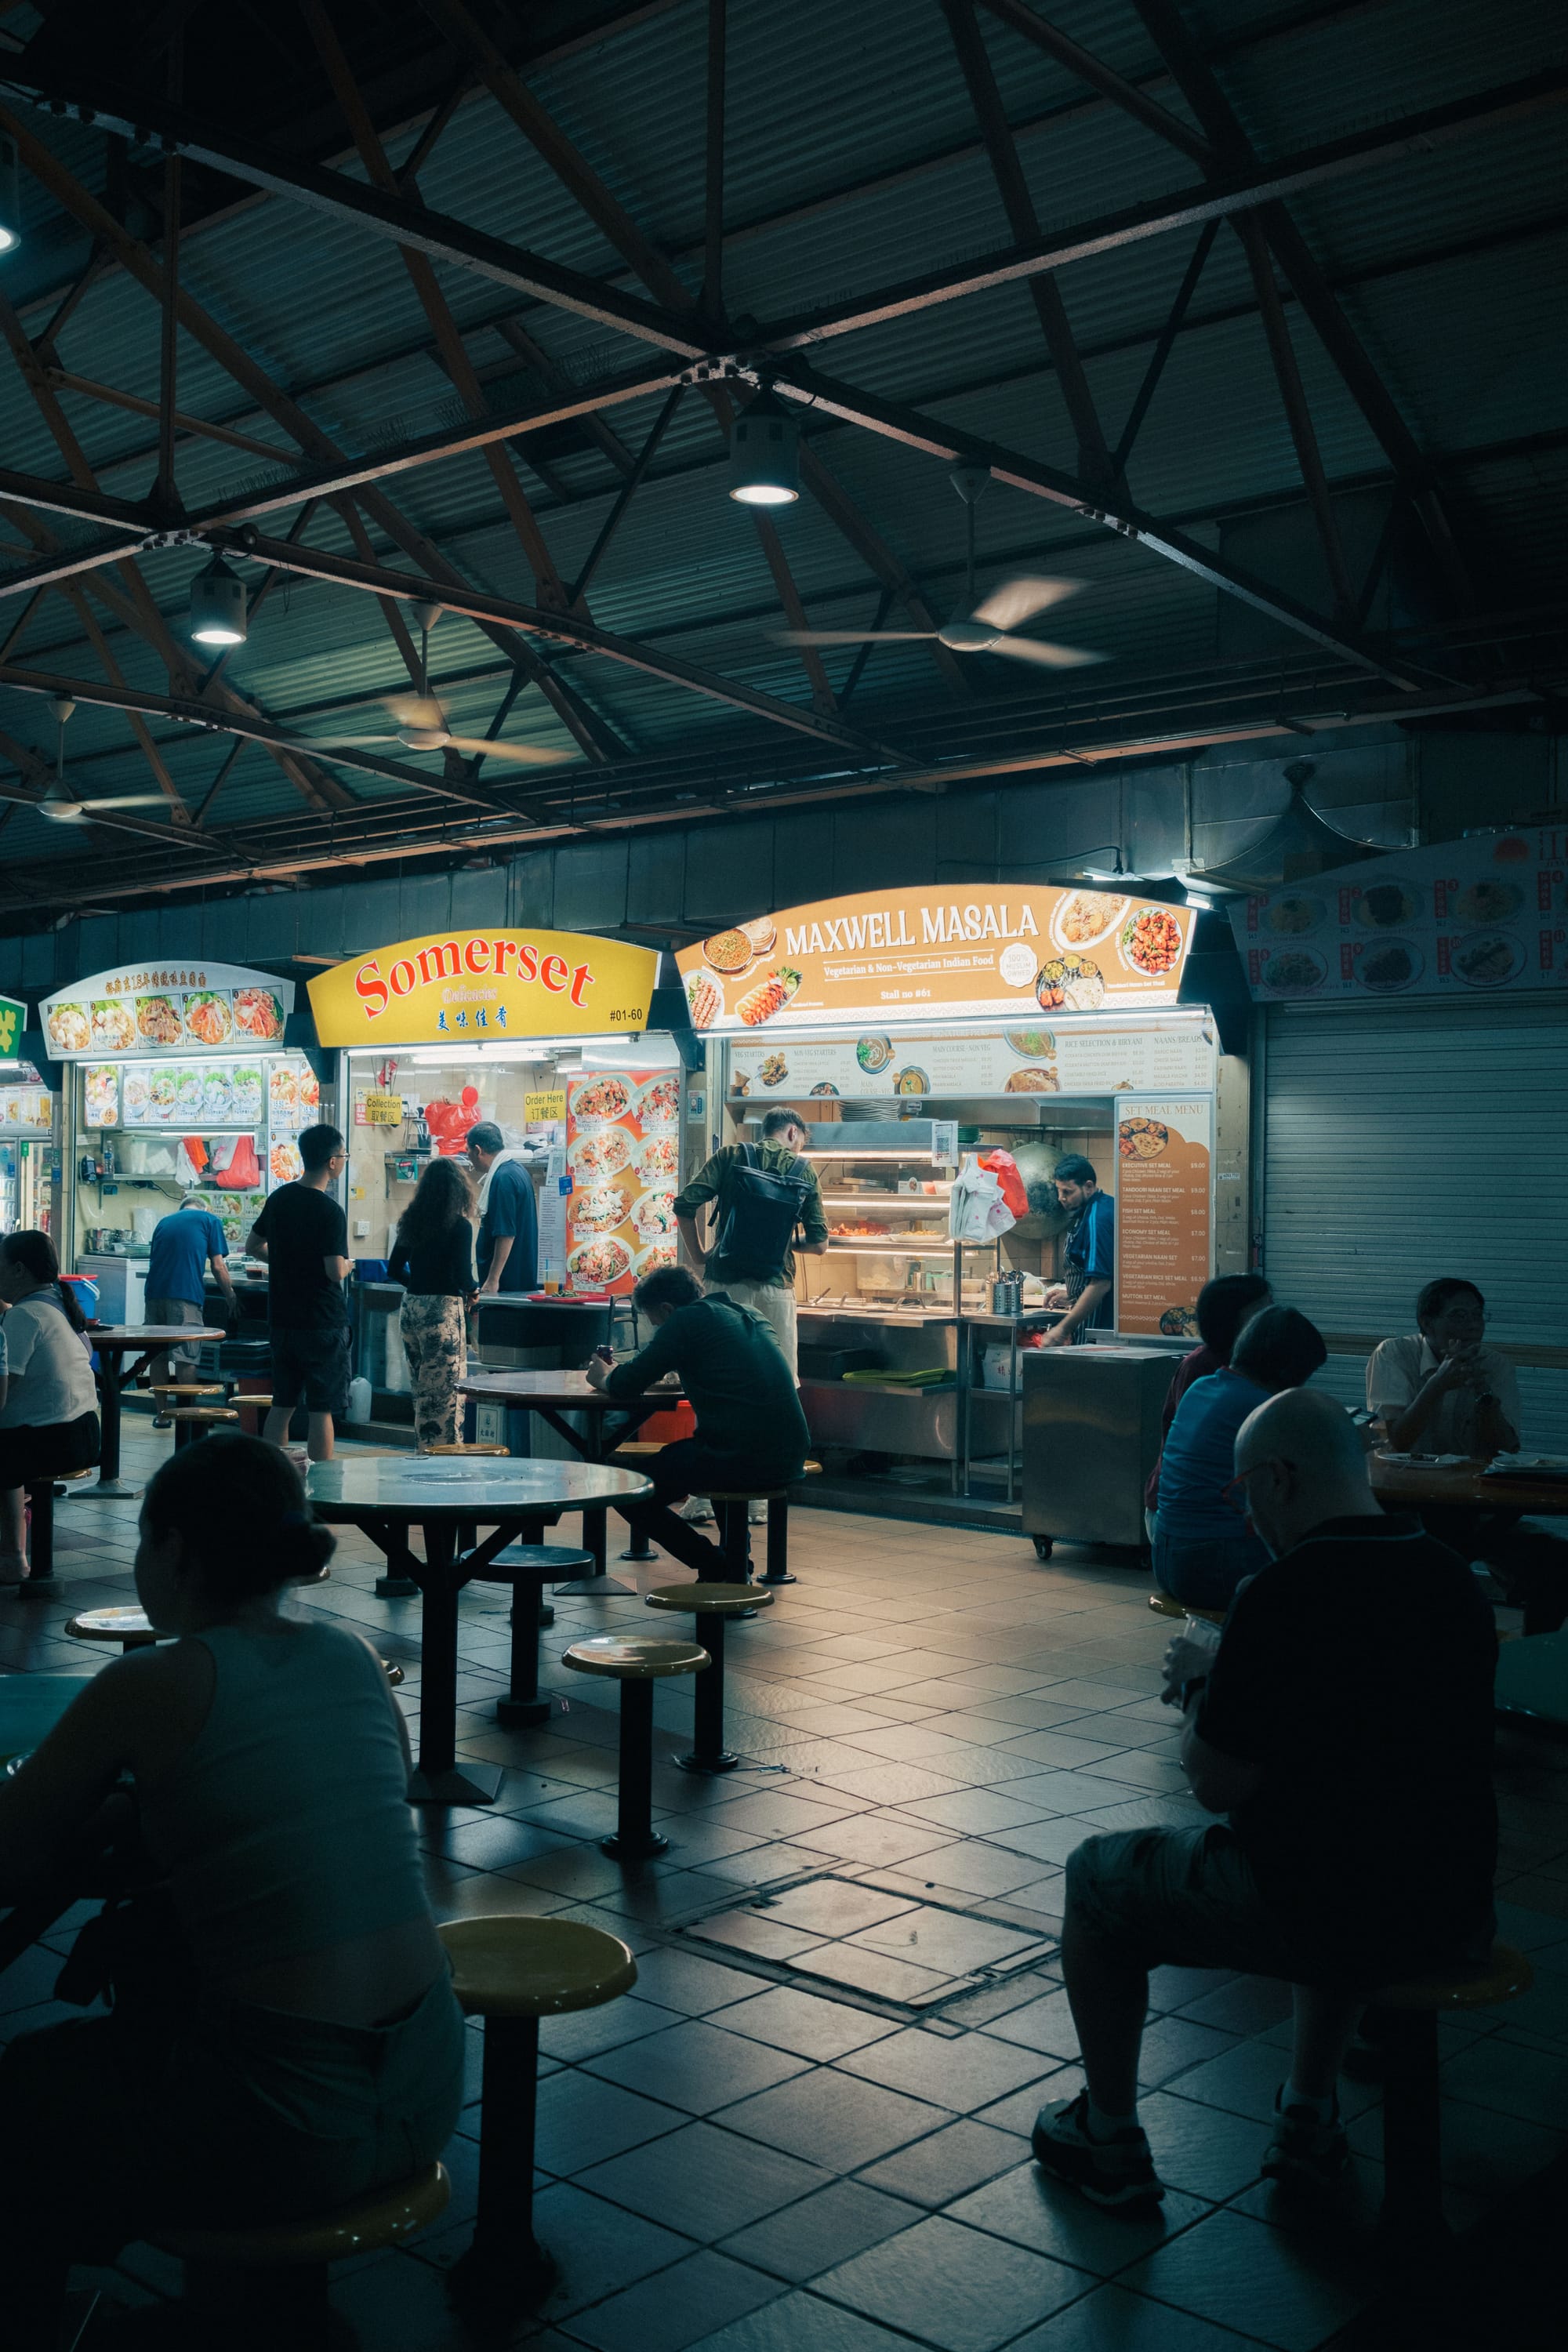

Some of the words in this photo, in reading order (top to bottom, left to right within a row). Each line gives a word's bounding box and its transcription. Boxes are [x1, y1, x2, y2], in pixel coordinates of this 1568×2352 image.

[785, 910, 916, 956] MAXWELL
[920, 905, 1040, 944] MASALA
[824, 964, 866, 978] Vegetarian
[876, 960, 941, 973] Non-Vegetarian
[943, 957, 971, 968] Indian
[972, 954, 993, 965] Food
[355, 938, 603, 1021] Somerset
[442, 985, 498, 1004] Delicacies
[880, 989, 899, 1000] Stall
[915, 989, 931, 997] #61
[437, 1006, 508, 1032] 美味佳肴
[610, 1008, 642, 1022] #01-60
[946, 1044, 965, 1053] COURSE
[1079, 1039, 1110, 1047] SELECTION
[1118, 1037, 1142, 1046] BIRYANI
[367, 1098, 401, 1109] Collection
[526, 1094, 546, 1106] Order
[548, 1093, 564, 1104] Here
[372, 1110, 396, 1123] 取餐区
[532, 1107, 558, 1120] 订餐区
[1125, 1106, 1142, 1116] SET
[1145, 1105, 1172, 1115] MEAL
[1175, 1105, 1203, 1115] MENU
